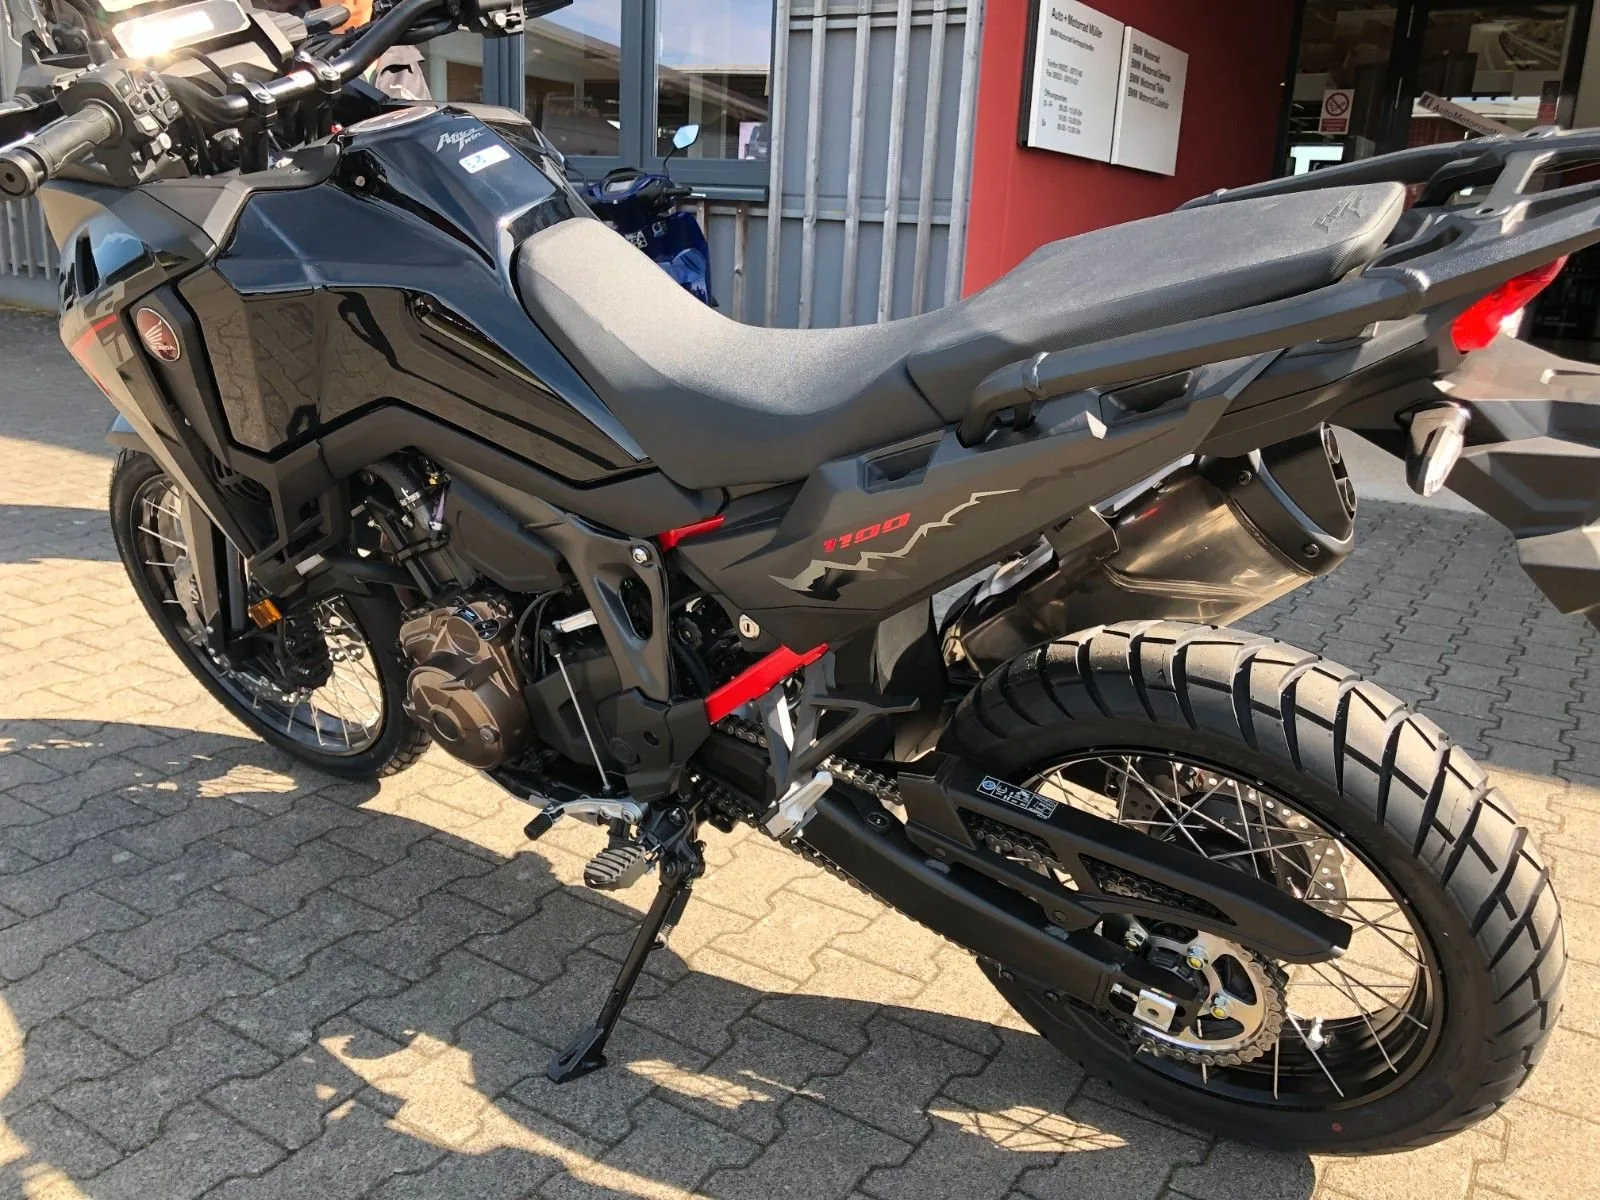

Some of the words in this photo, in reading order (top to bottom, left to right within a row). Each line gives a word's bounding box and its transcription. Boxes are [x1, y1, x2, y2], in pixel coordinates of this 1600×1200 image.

[1051, 7, 1063, 22] Auto
[1067, 14, 1088, 33] Motorrad
[1132, 43, 1143, 56] BMW
[1143, 49, 1160, 63] Motorrad
[1131, 58, 1141, 70] BMW
[1142, 63, 1158, 77] Motorrad
[1129, 72, 1140, 84] BMW
[1140, 77, 1156, 91] Motorrad
[1128, 87, 1138, 98] BMW
[1139, 91, 1155, 105] Motorrad
[823, 512, 912, 553] 1100
